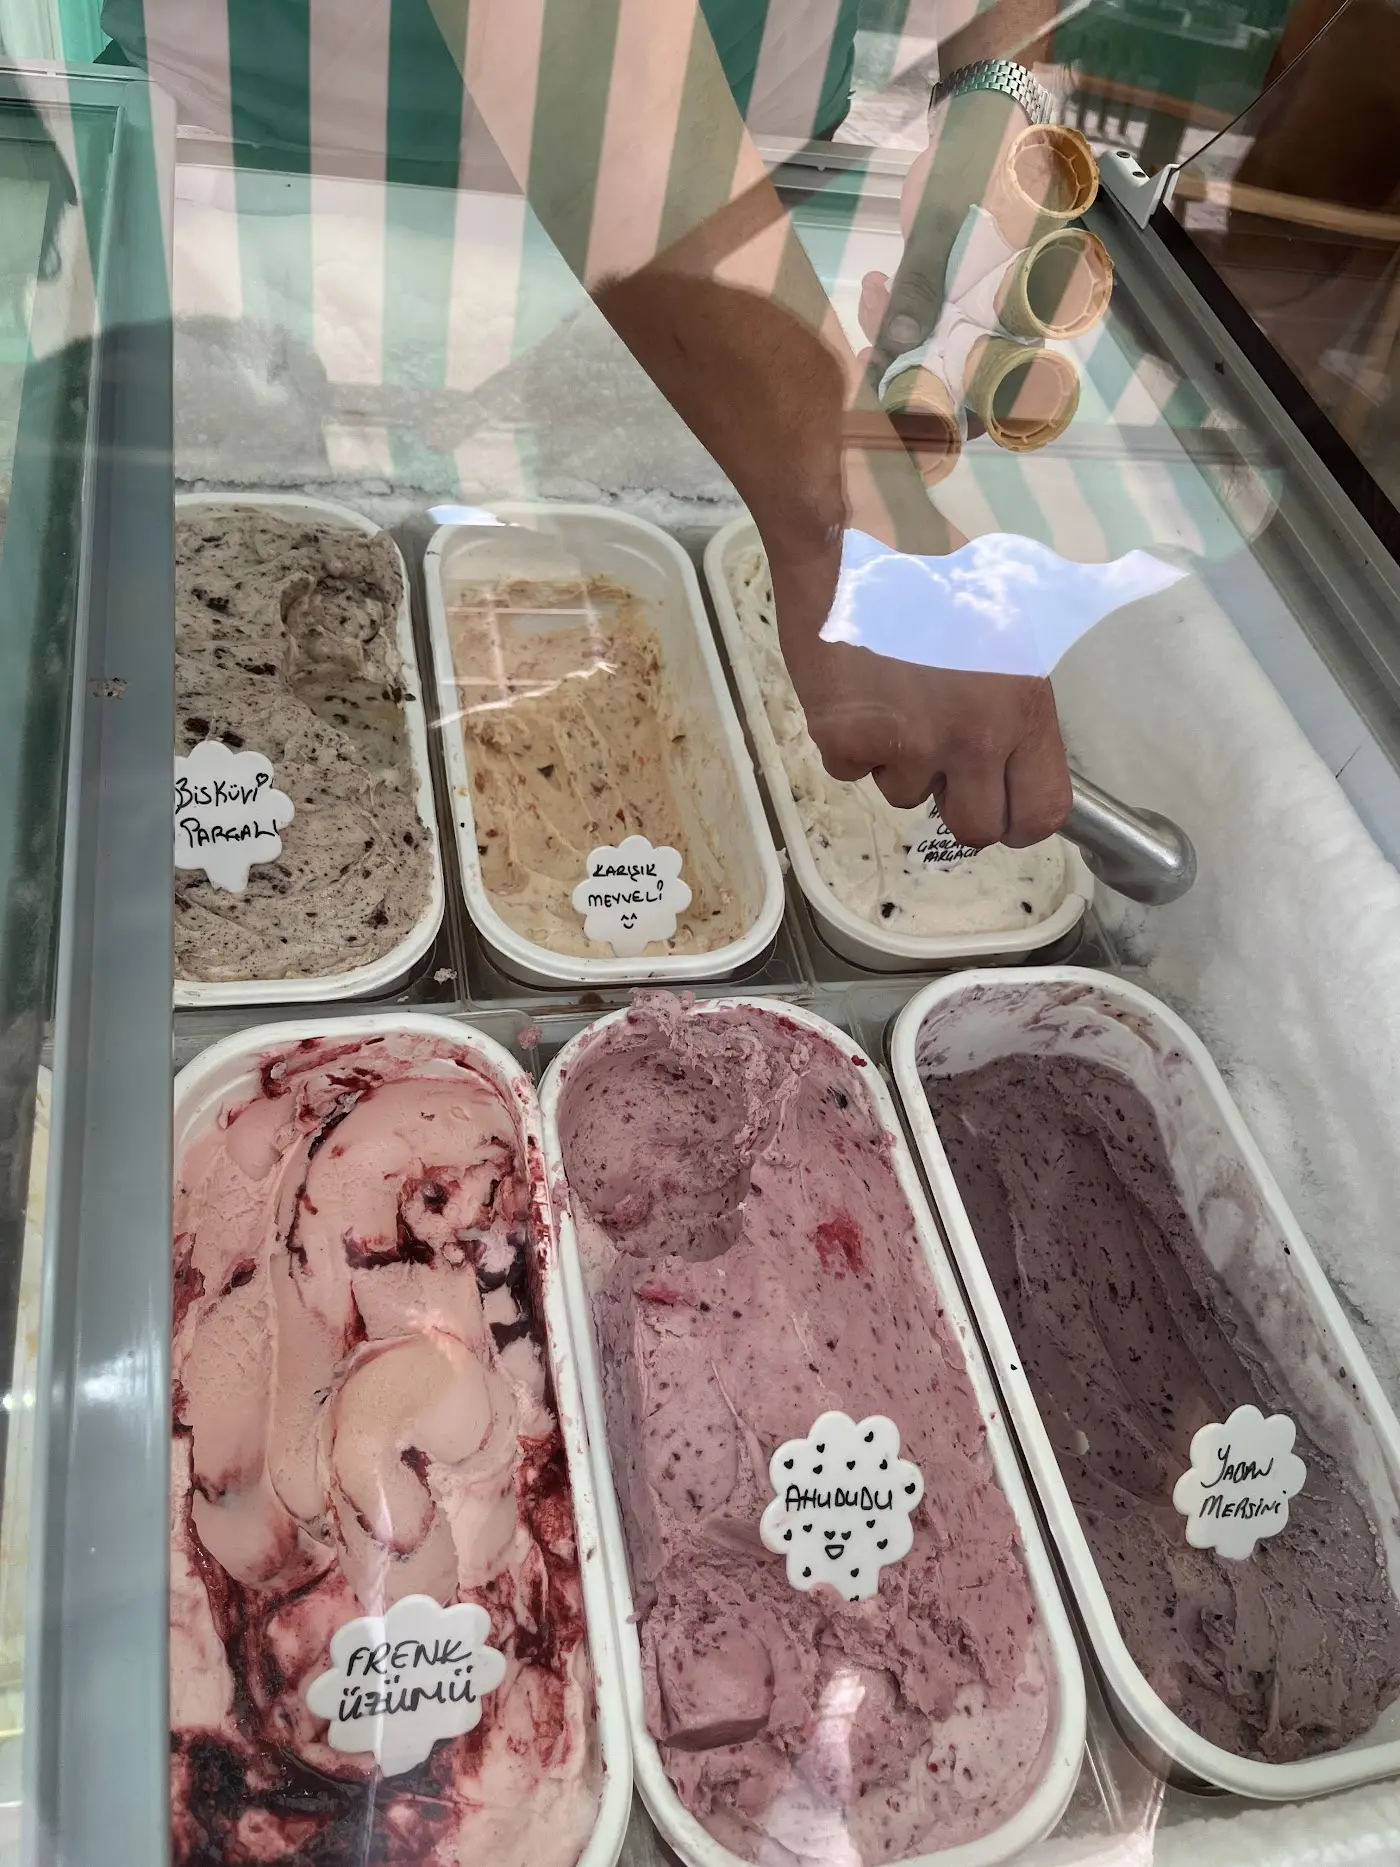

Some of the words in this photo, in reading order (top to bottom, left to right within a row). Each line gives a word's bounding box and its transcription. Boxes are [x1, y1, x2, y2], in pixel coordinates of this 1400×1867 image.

[592, 863, 658, 882] KARIŞIK
[1200, 1444, 1274, 1488] YABAN
[785, 1485, 893, 1512] AHUDUDU
[346, 1639, 473, 1677] FRENK
[339, 1665, 477, 1722] ÜZÜMÜ
